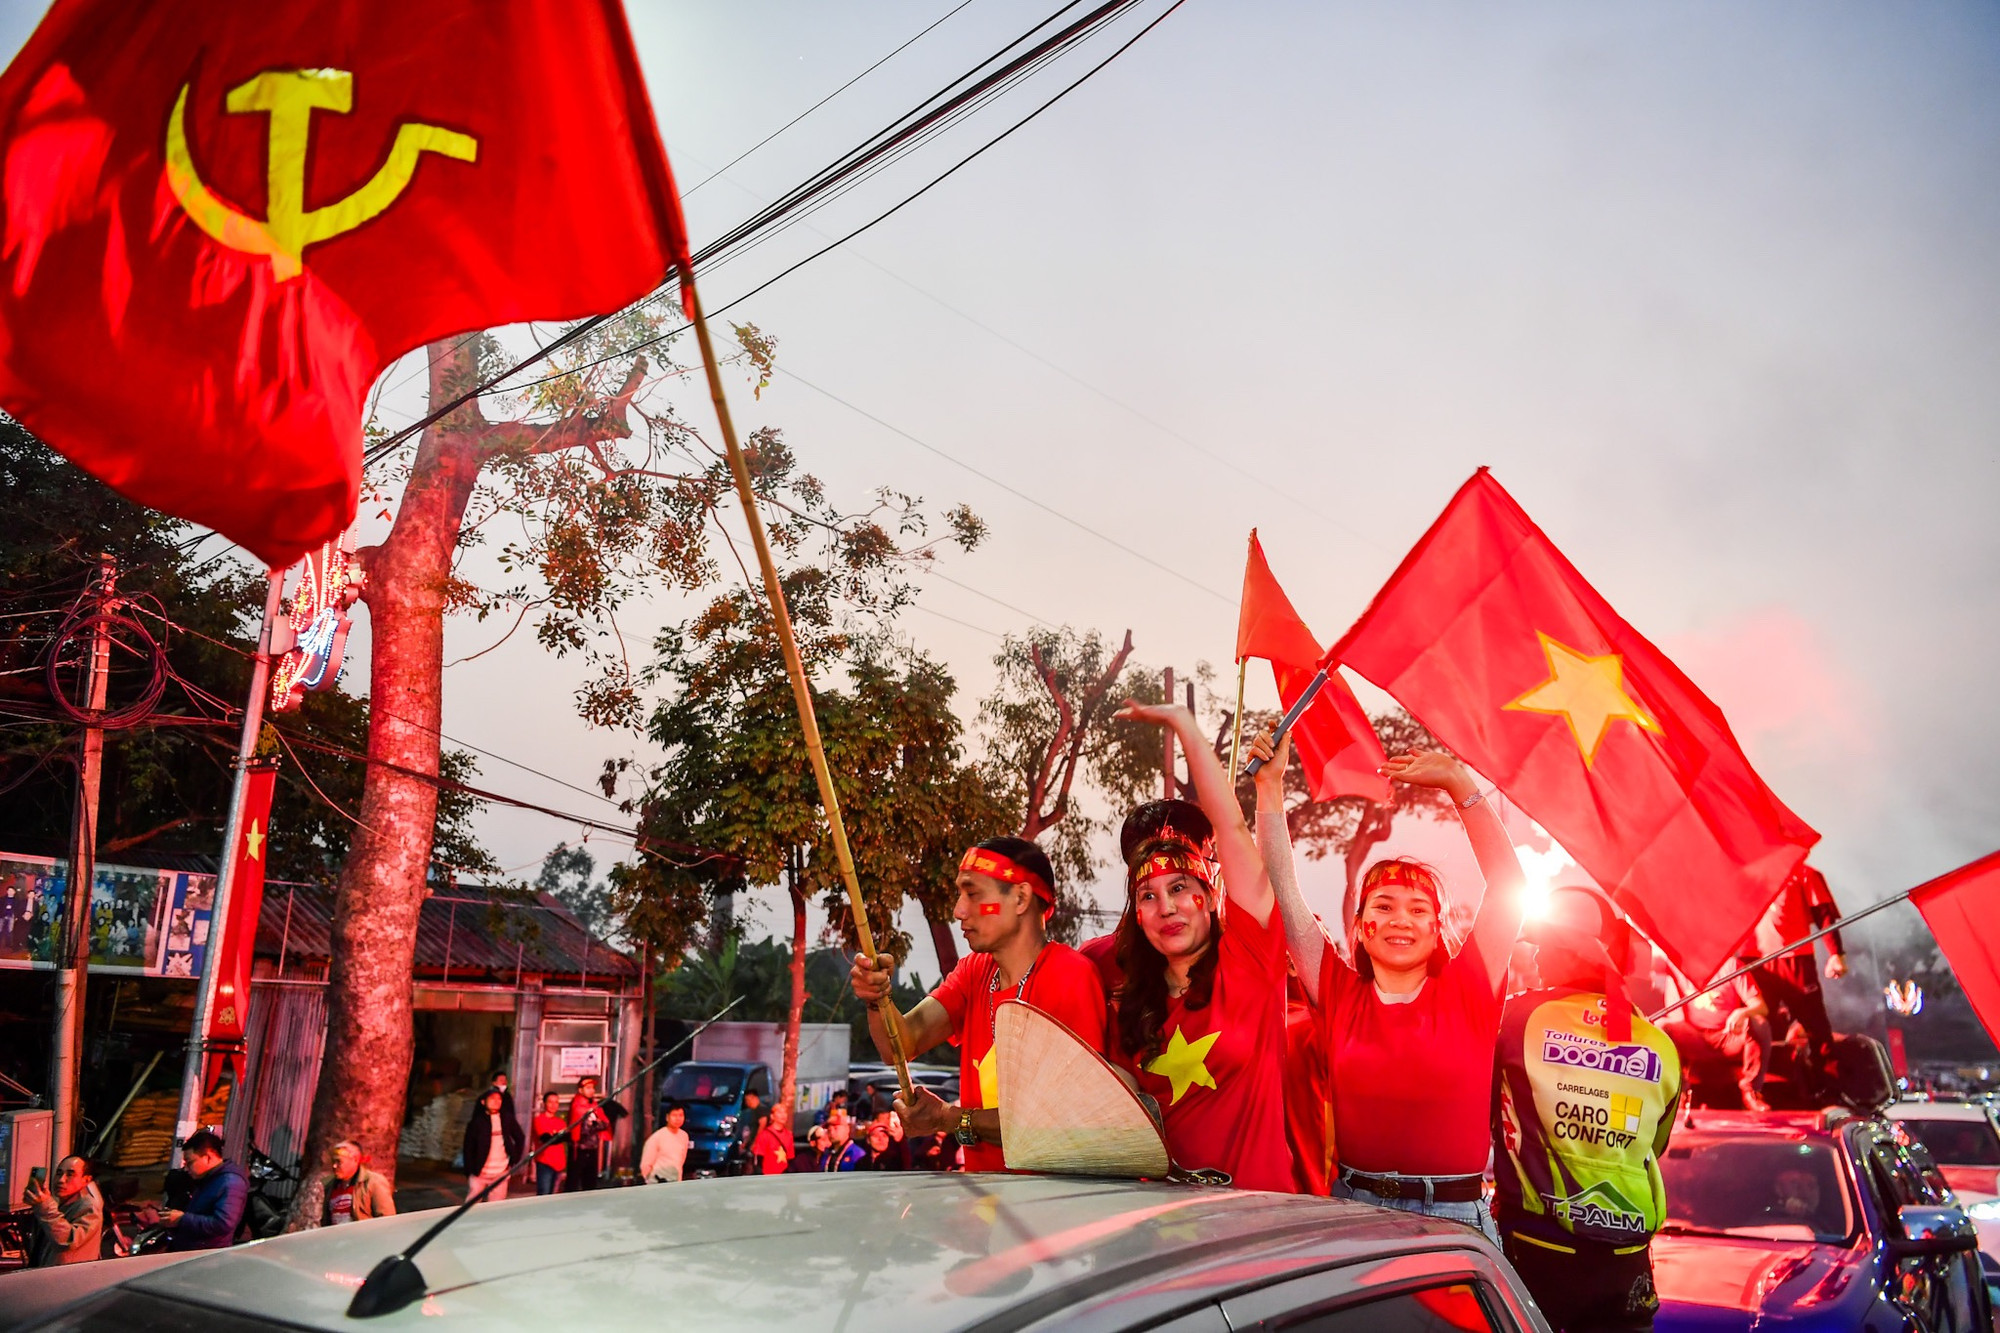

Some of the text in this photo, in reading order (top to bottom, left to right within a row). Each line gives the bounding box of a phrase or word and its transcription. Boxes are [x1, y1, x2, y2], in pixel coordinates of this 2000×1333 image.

[1545, 1030, 1606, 1048] Toitures
[1556, 1082, 1610, 1099] CARRELAGES
[1555, 1101, 1608, 1126] CARO
[1554, 1121, 1636, 1149] CONFORT
